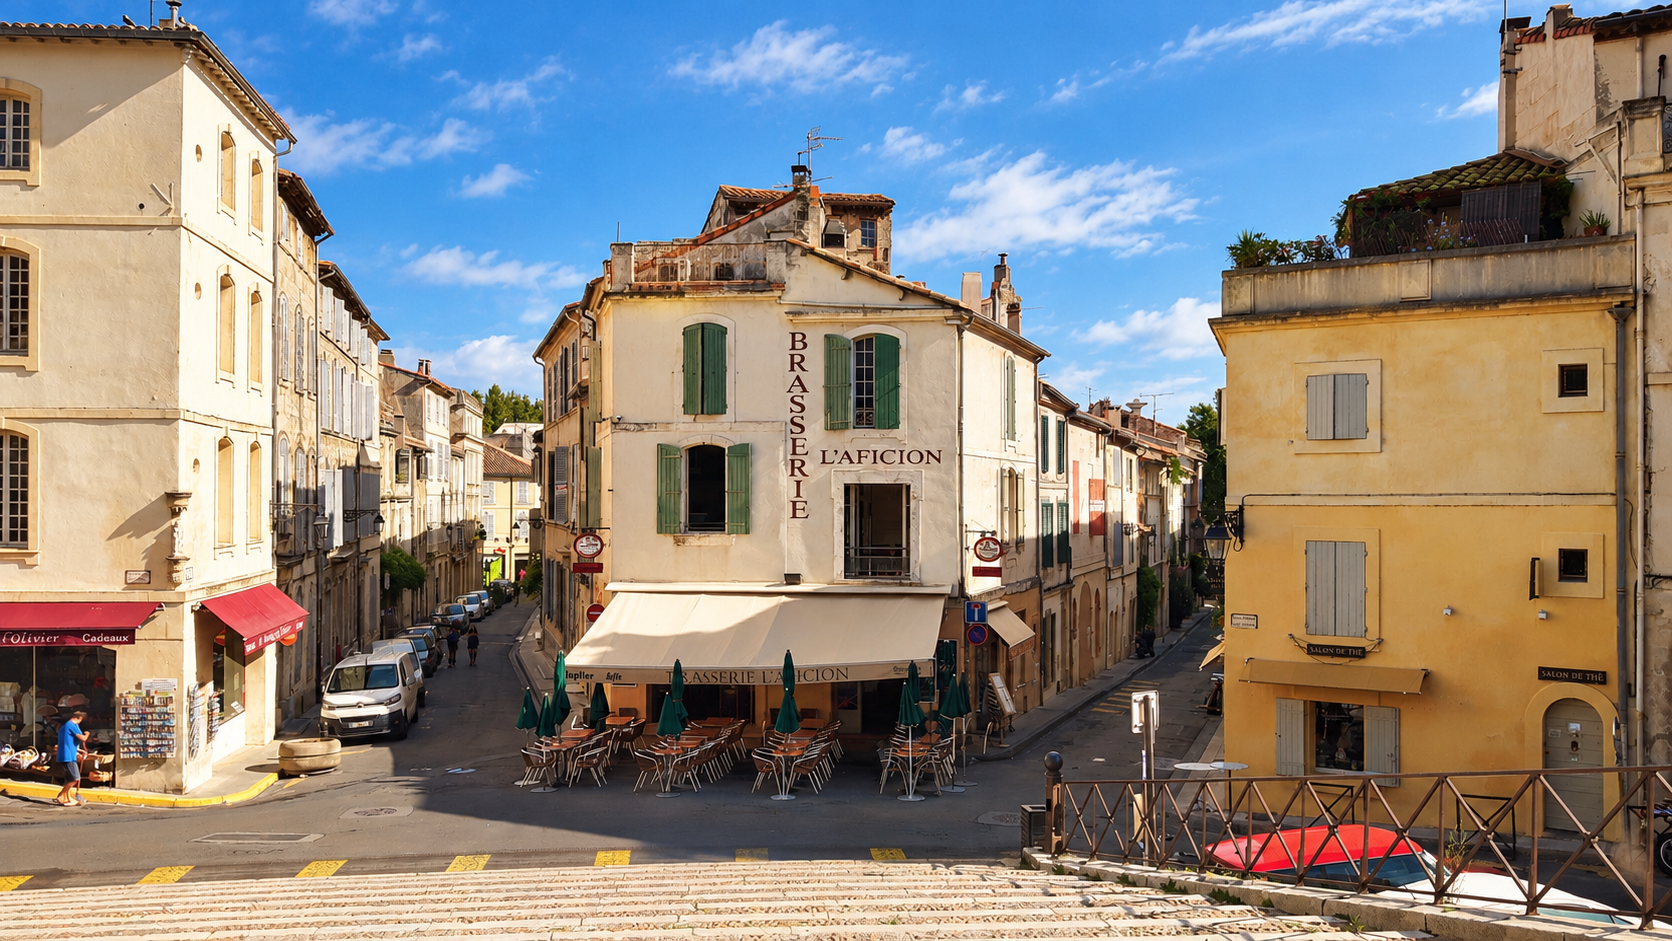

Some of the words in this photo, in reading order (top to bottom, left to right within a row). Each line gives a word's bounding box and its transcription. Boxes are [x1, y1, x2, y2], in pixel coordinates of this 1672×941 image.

[786, 331, 810, 519] BRASSERIE
[820, 449, 943, 465] L'AFICION
[82, 633, 129, 643] Cadeaux
[1541, 669, 1569, 679] SALON
[1571, 672, 1583, 680] DE
